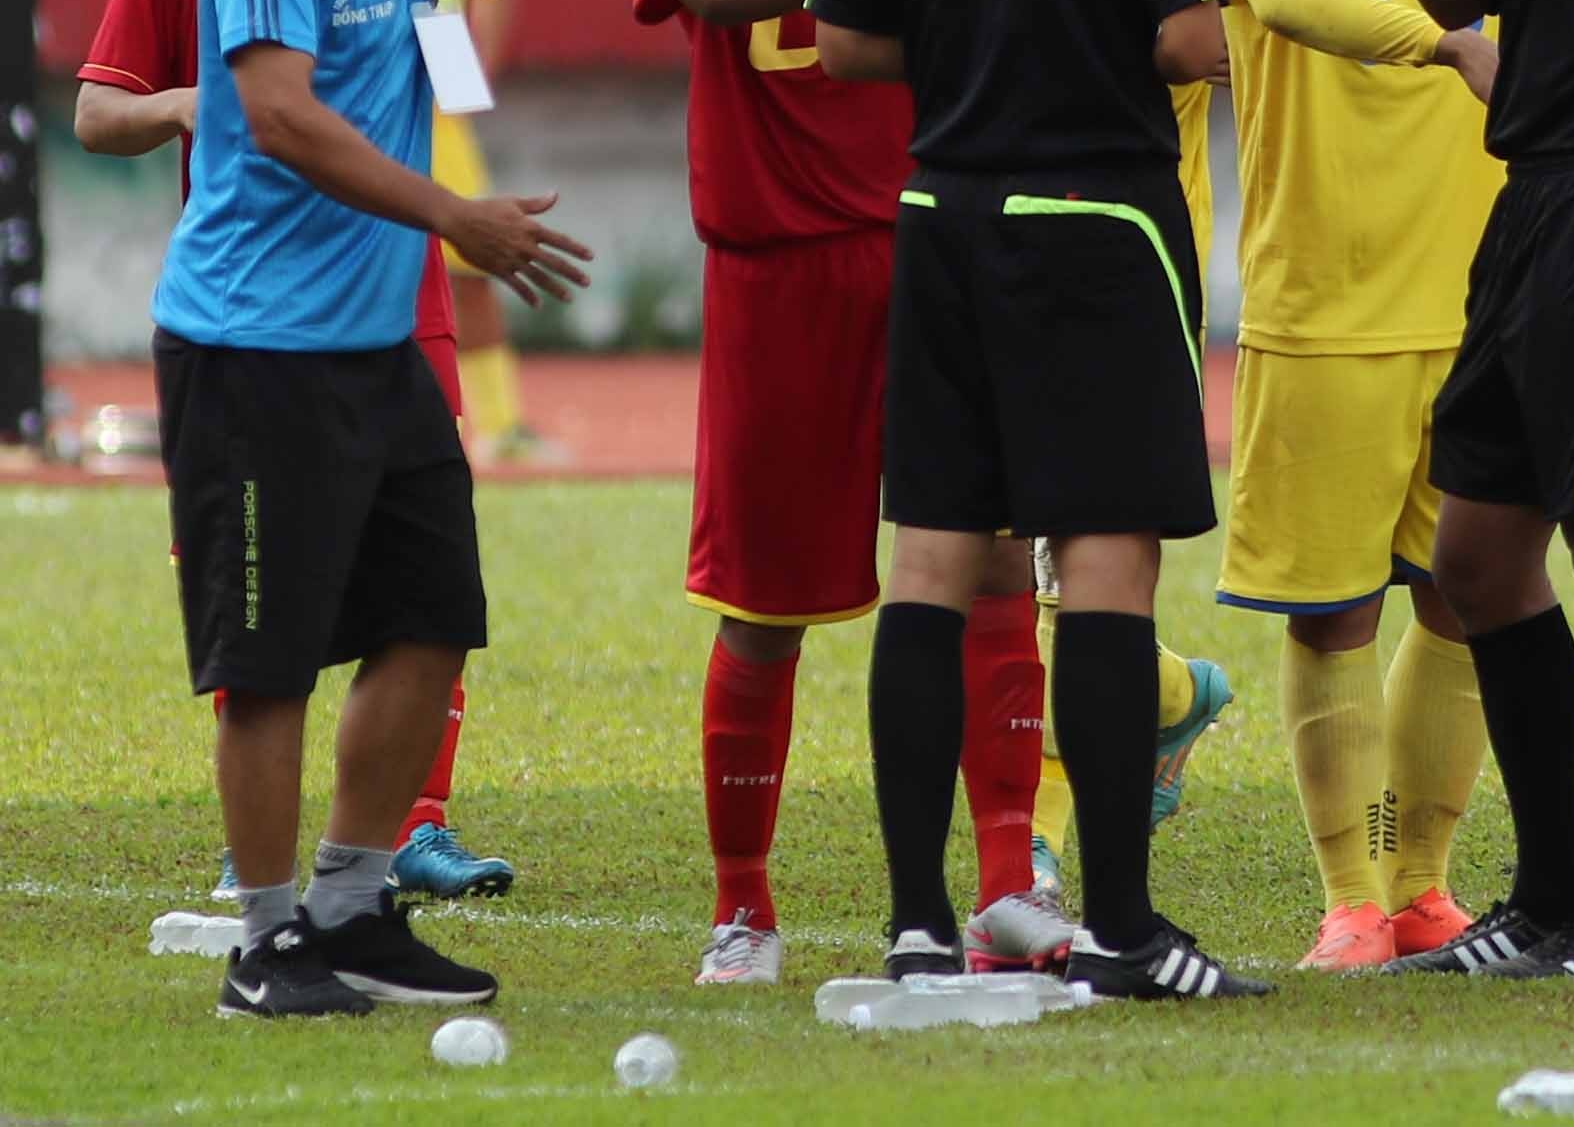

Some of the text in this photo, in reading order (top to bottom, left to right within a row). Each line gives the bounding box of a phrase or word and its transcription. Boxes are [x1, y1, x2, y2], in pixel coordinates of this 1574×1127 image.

[242, 480, 258, 630] PORSCHE DESIGN
[1366, 802, 1381, 861] mitre
[1383, 790, 1398, 852] mitre
